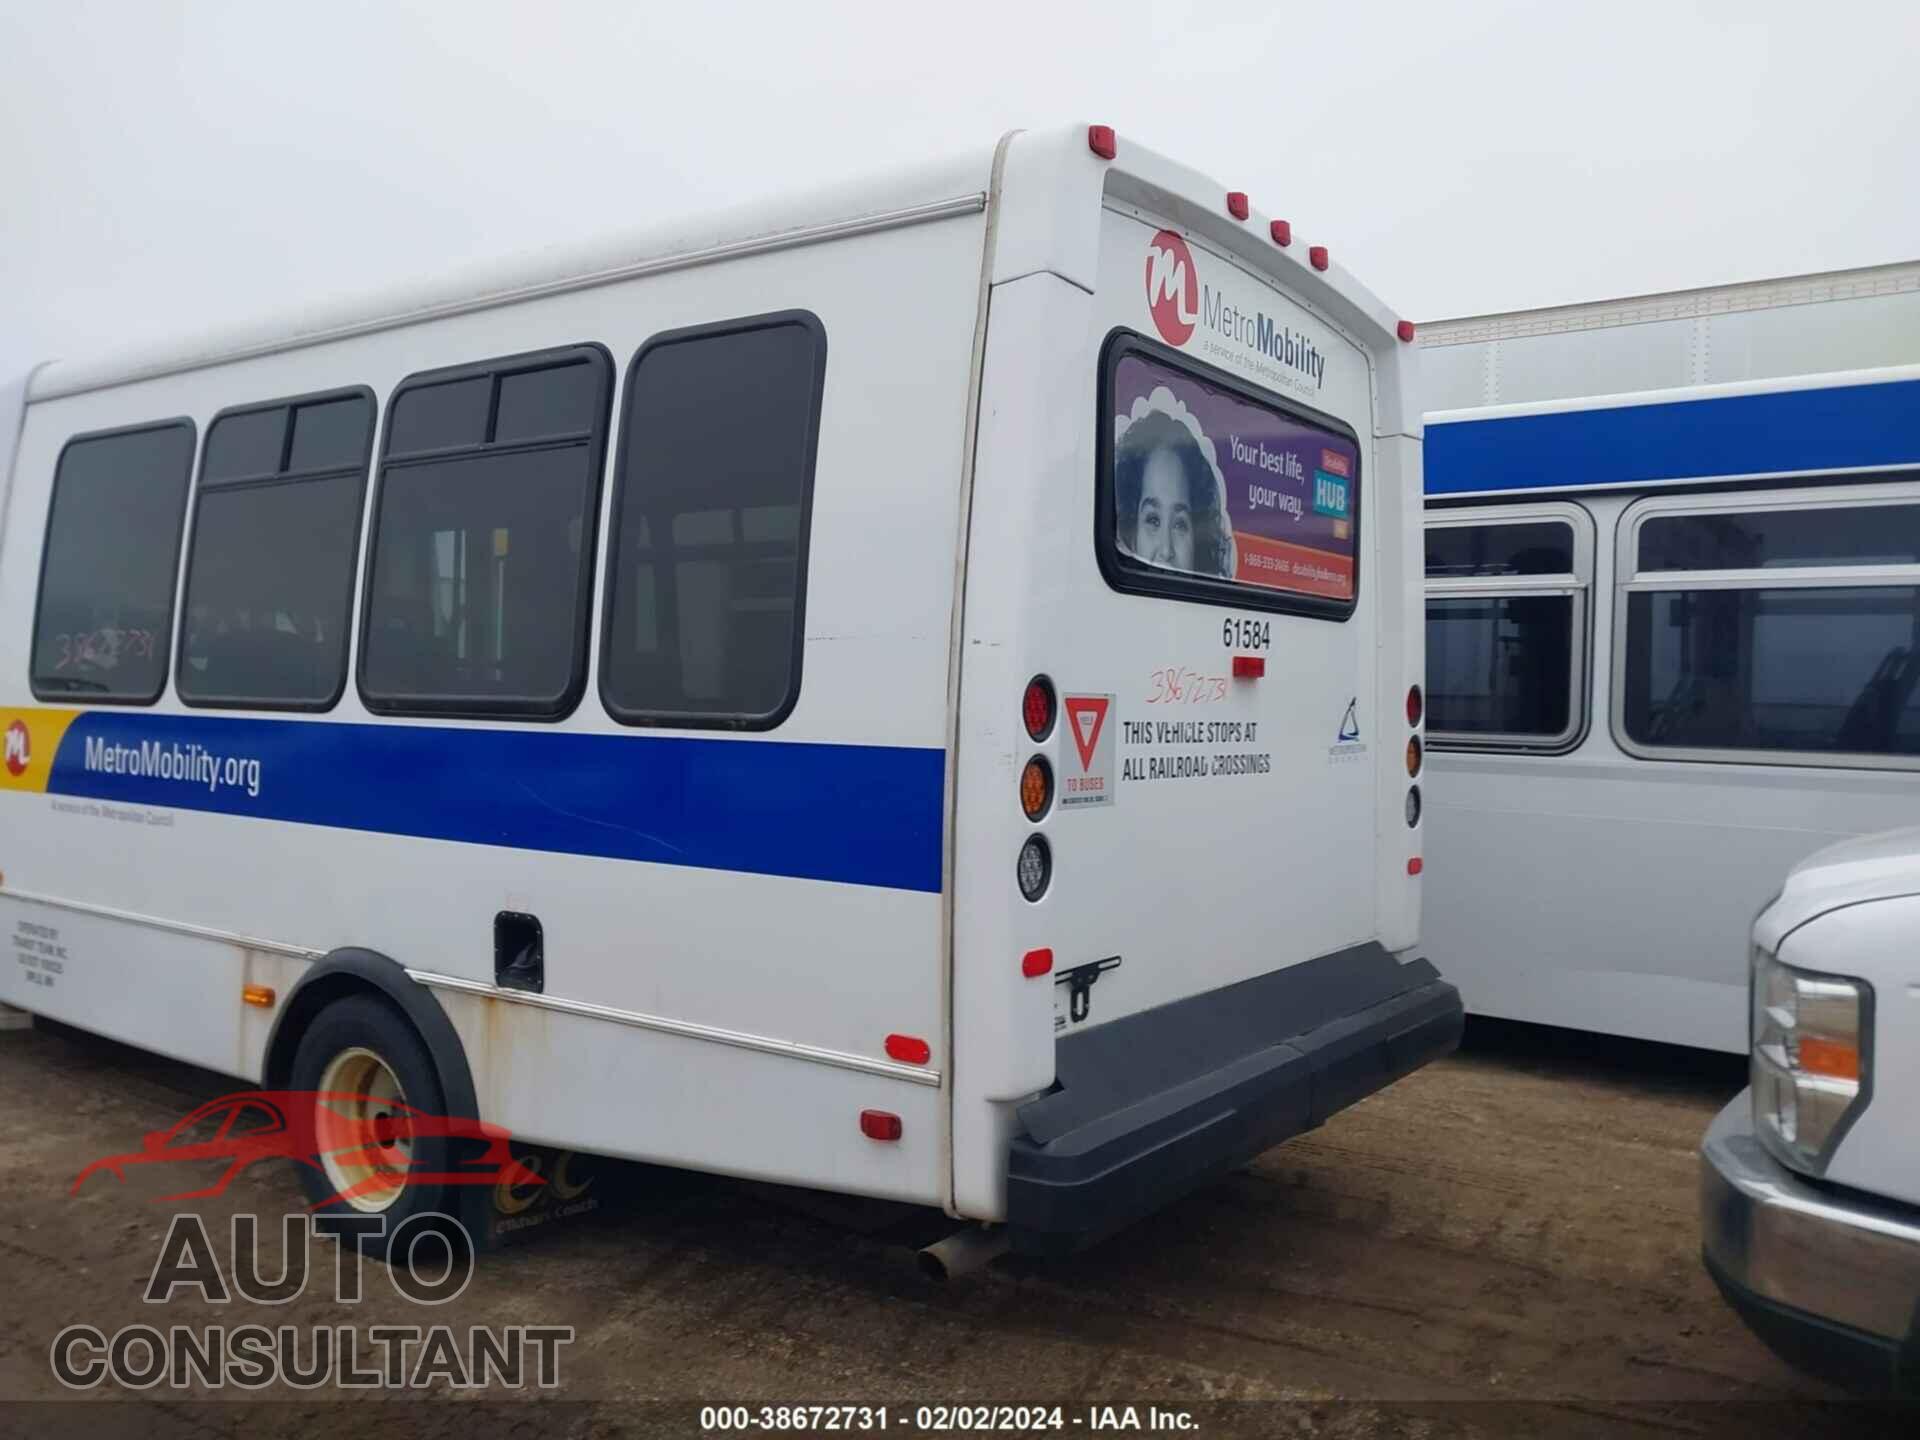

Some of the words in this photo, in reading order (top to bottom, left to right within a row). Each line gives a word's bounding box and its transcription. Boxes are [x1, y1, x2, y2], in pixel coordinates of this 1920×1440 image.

[1203, 284, 1325, 389] MetroMobility
[1230, 435, 1258, 466] Your
[1260, 442, 1284, 476] best
[1286, 451, 1304, 487] life,
[1249, 484, 1278, 510] your
[1278, 493, 1304, 521] way.
[1316, 477, 1346, 512] HUB
[1223, 618, 1270, 650] 61584
[1123, 721, 1152, 744] THIS
[1156, 721, 1204, 744] VEHICLE
[1207, 722, 1242, 743] STOPS
[1243, 722, 1257, 743] AT
[85, 735, 261, 797] MetroMobility.org
[1122, 758, 1146, 781] ALL
[1149, 755, 1208, 780] RAILROAD
[1210, 753, 1271, 777] CROSSINGS
